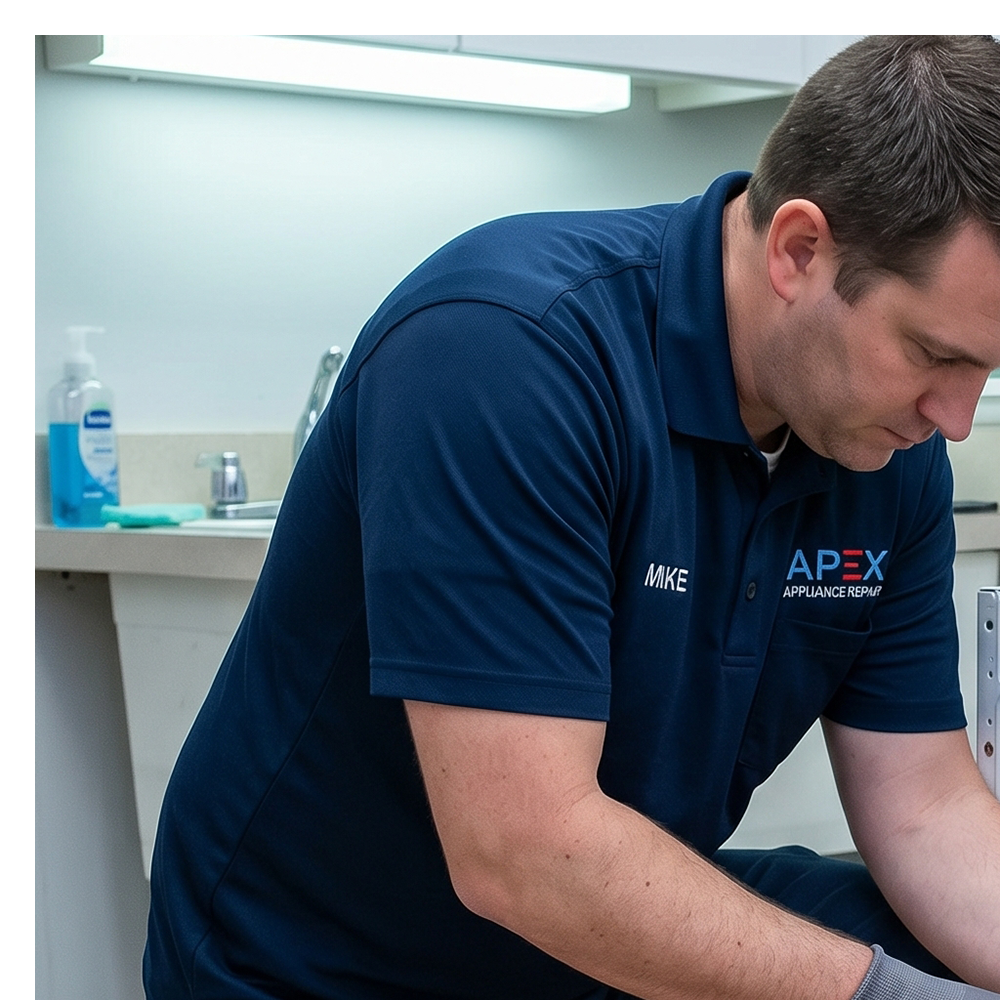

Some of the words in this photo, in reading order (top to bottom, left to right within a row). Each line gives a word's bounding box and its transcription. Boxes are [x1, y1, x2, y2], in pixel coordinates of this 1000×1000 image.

[644, 562, 689, 593] MIKE
[786, 549, 888, 581] APEX
[782, 585, 846, 598] APPLIANCE
